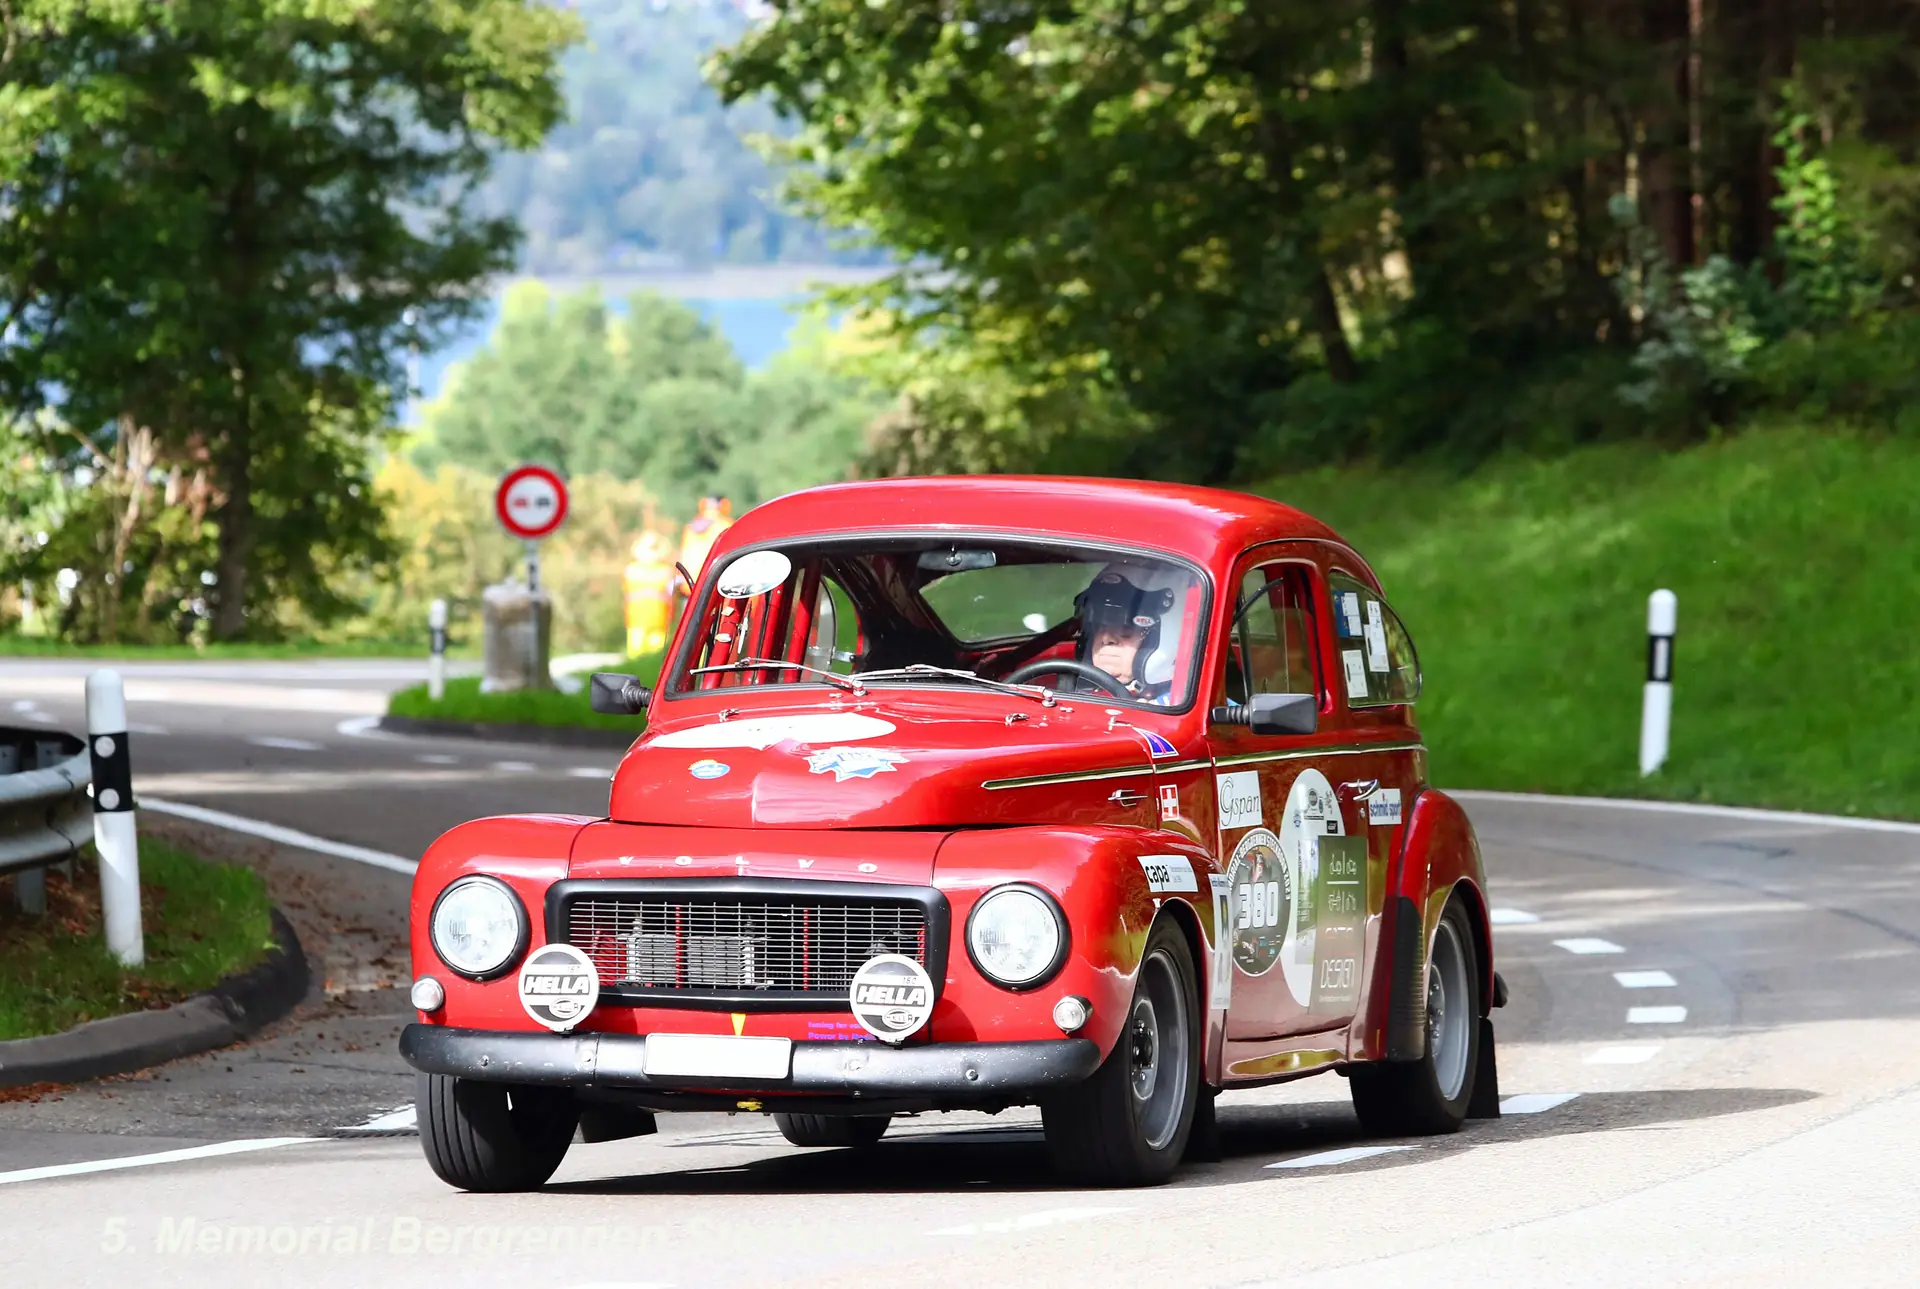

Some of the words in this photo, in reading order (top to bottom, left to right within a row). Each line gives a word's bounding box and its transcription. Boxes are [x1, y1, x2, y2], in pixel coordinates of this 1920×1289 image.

[618, 855, 878, 874] VOLVO
[1145, 864, 1171, 890] capa
[1238, 881, 1279, 930] 380
[524, 975, 590, 994] HELLA
[857, 987, 924, 1005] HELLA
[807, 1032, 837, 1040] Power
[838, 1033, 849, 1041] by
